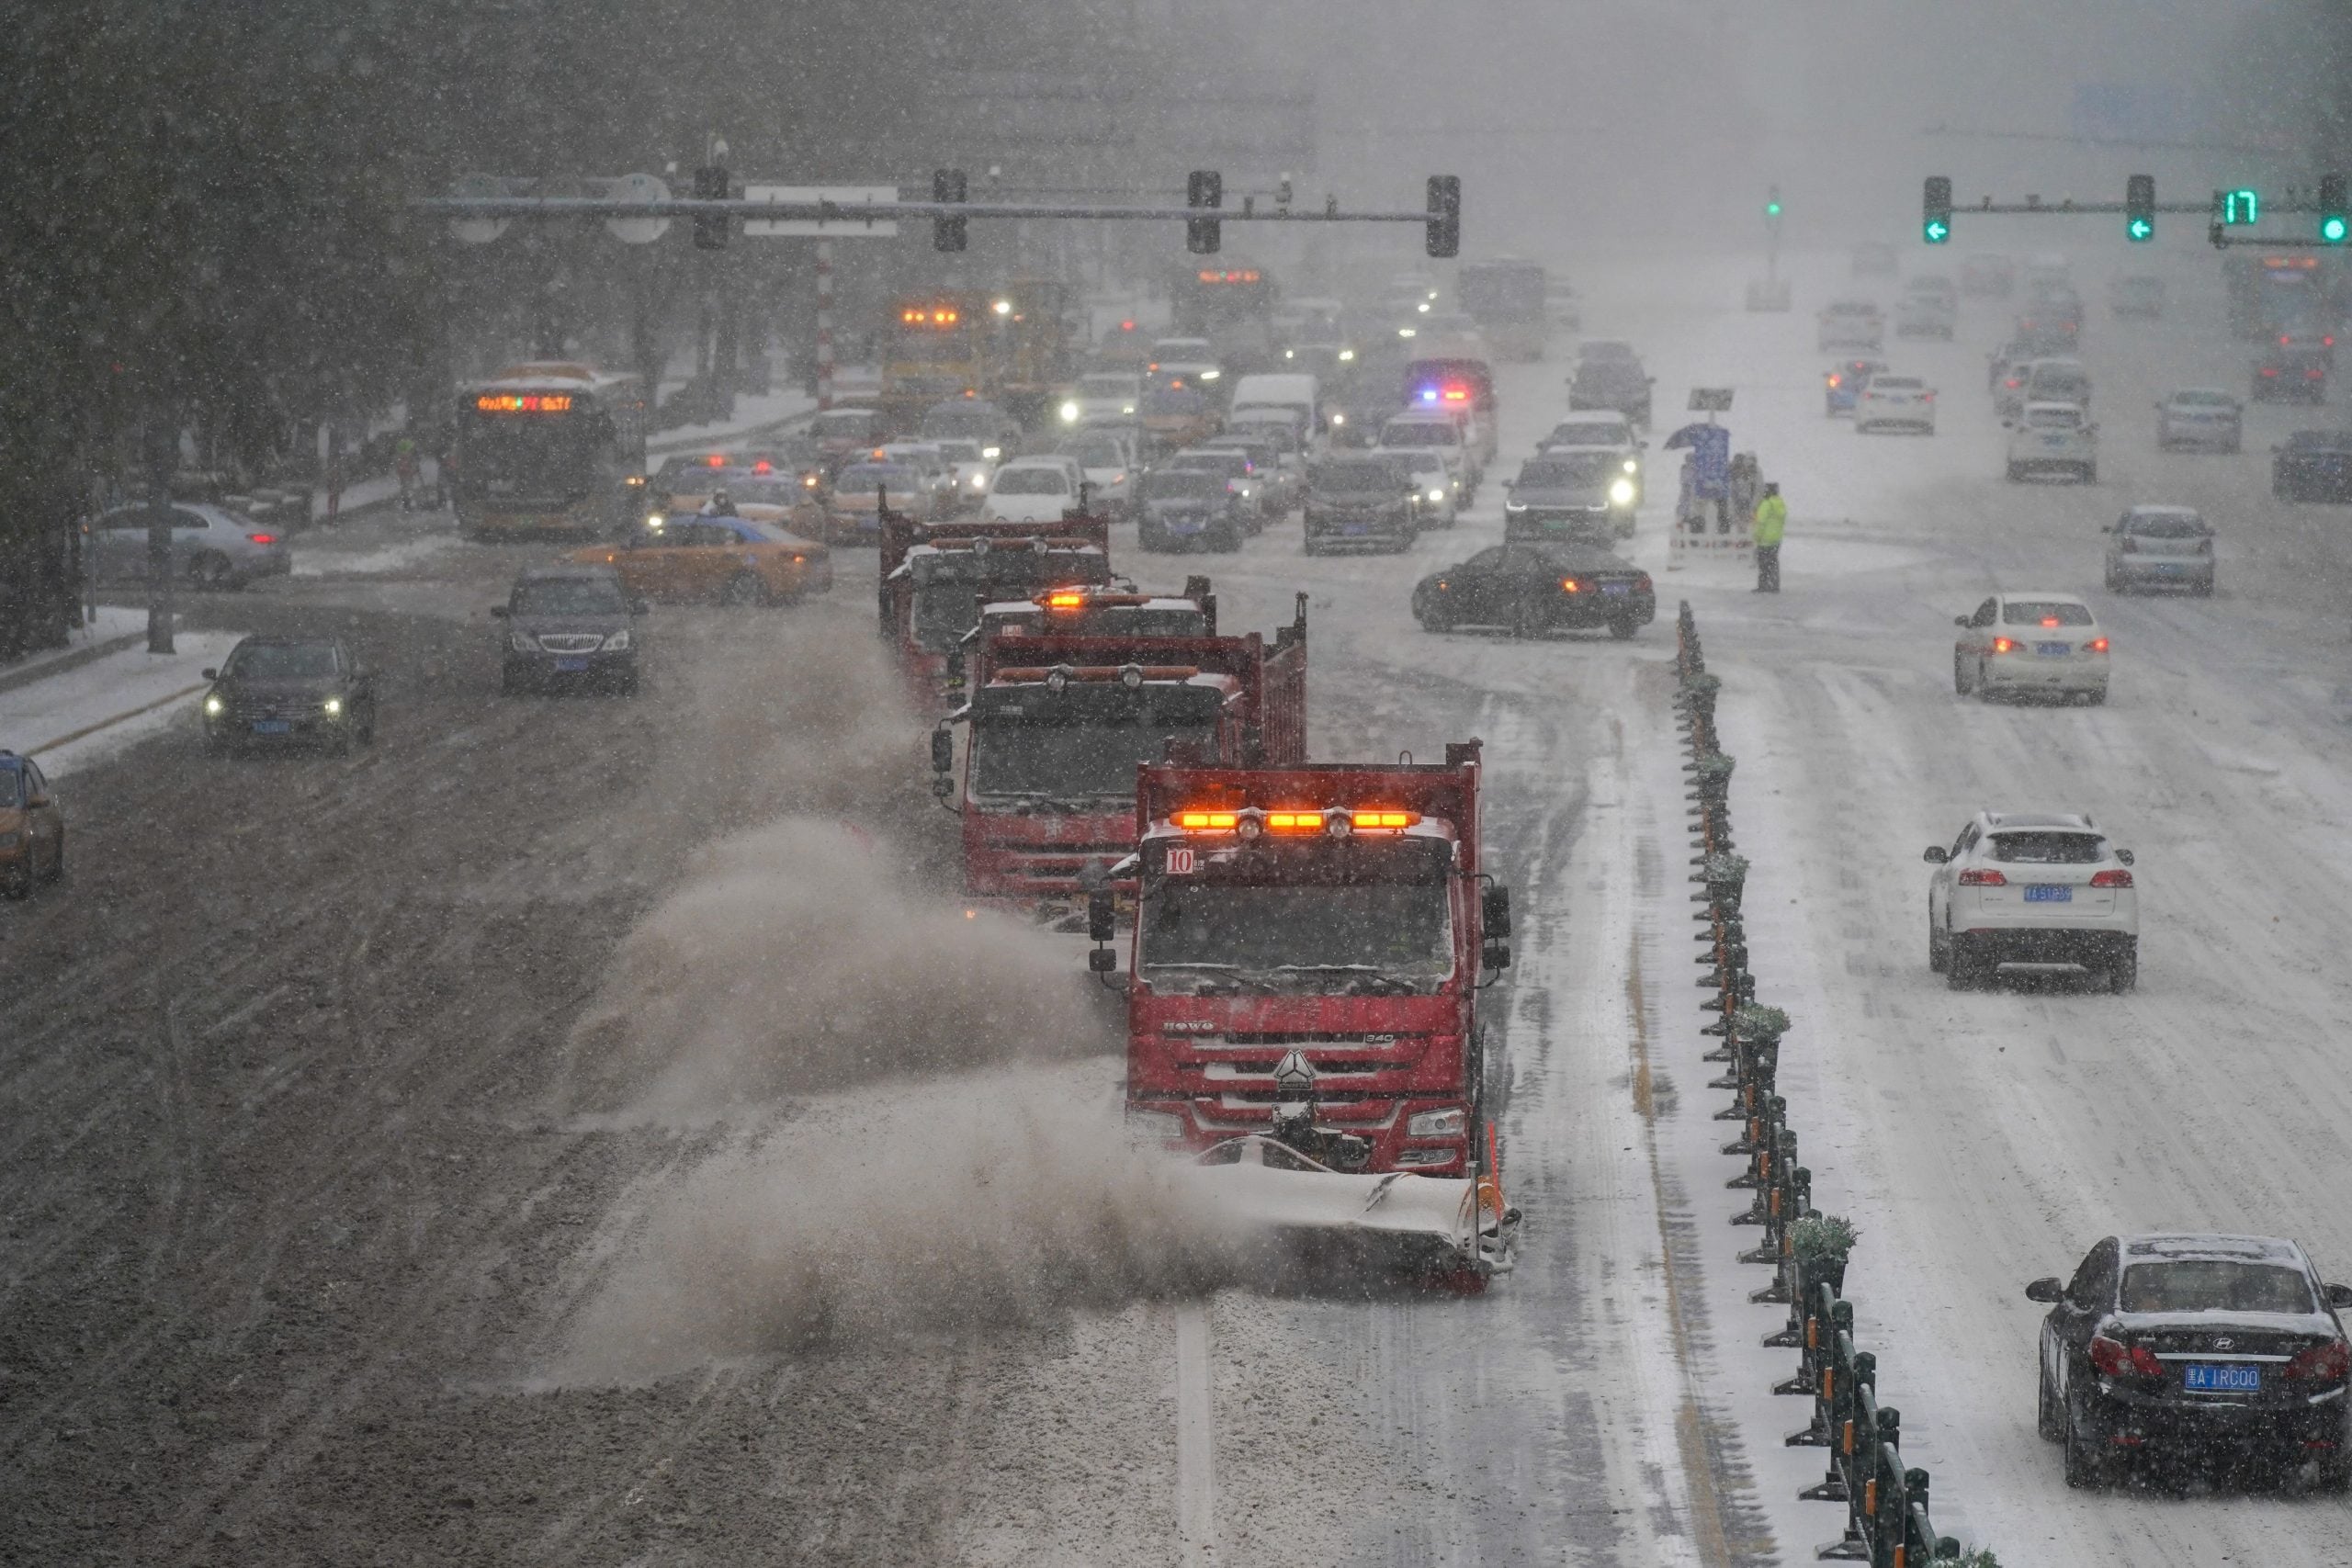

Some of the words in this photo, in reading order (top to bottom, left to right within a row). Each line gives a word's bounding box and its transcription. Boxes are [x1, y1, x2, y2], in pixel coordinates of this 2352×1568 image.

[2227, 191, 2256, 223] 17
[1169, 851, 1192, 872] 10
[1366, 1034, 1394, 1043] 340
